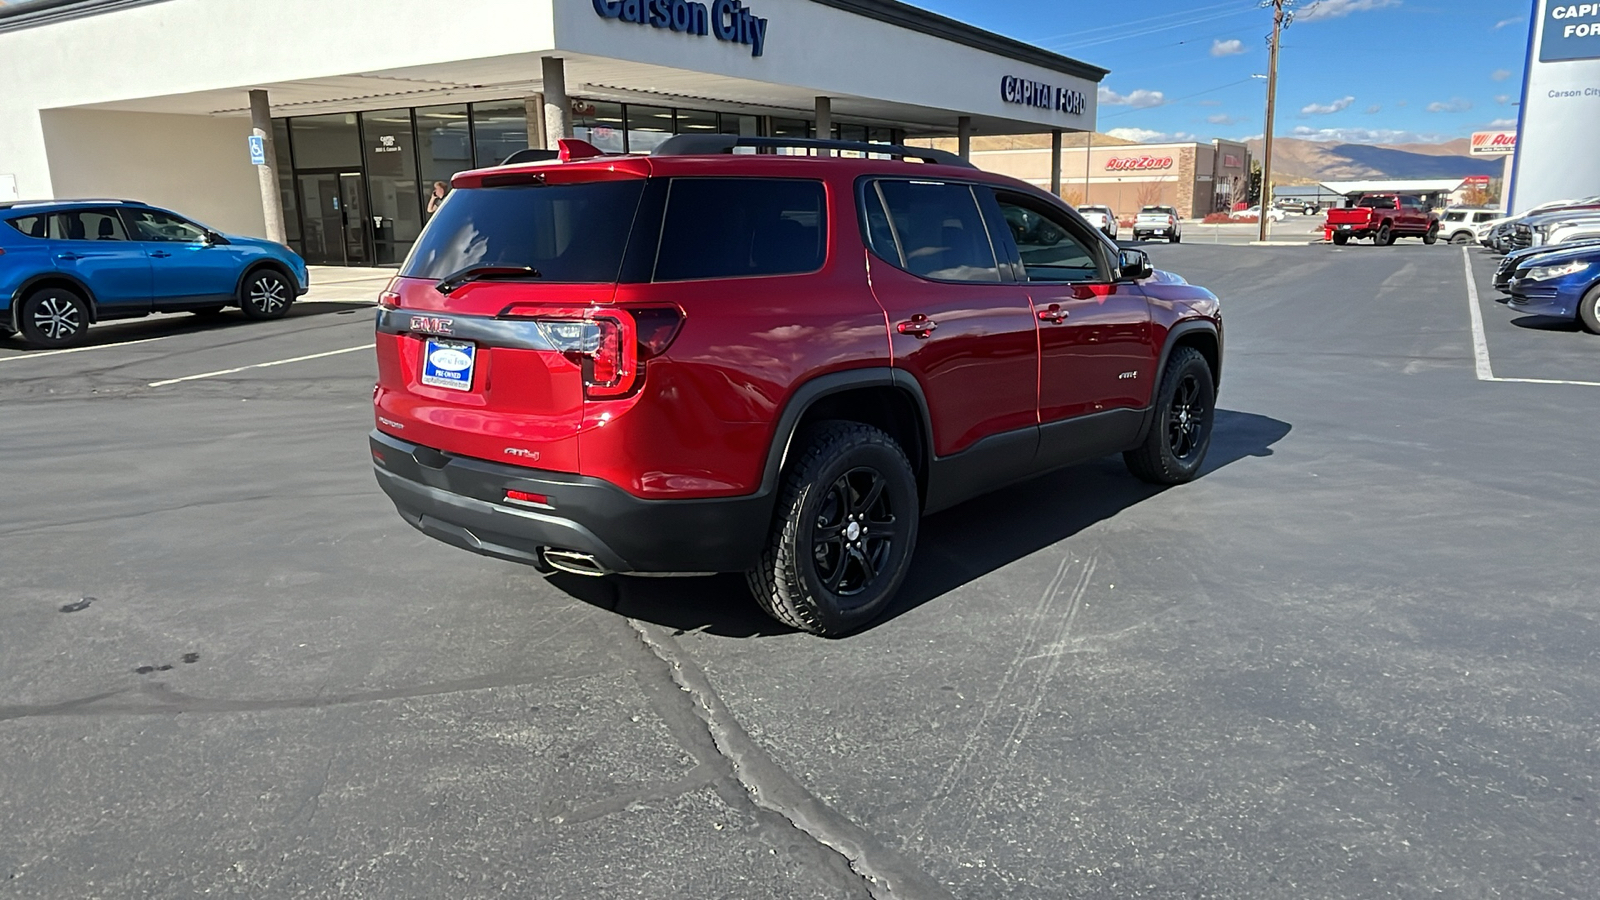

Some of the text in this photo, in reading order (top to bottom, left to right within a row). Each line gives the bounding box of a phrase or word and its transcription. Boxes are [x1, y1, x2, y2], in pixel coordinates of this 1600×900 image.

[1552, 3, 1600, 20] CAPI
[711, 0, 768, 57] City
[1001, 75, 1086, 115] CAPITAL FORD
[1548, 89, 1581, 98] Carson
[1106, 156, 1173, 171] AutoZone
[410, 316, 453, 334] GMC
[435, 369, 461, 379] PRE-OWNED
[504, 447, 540, 461] AT4
